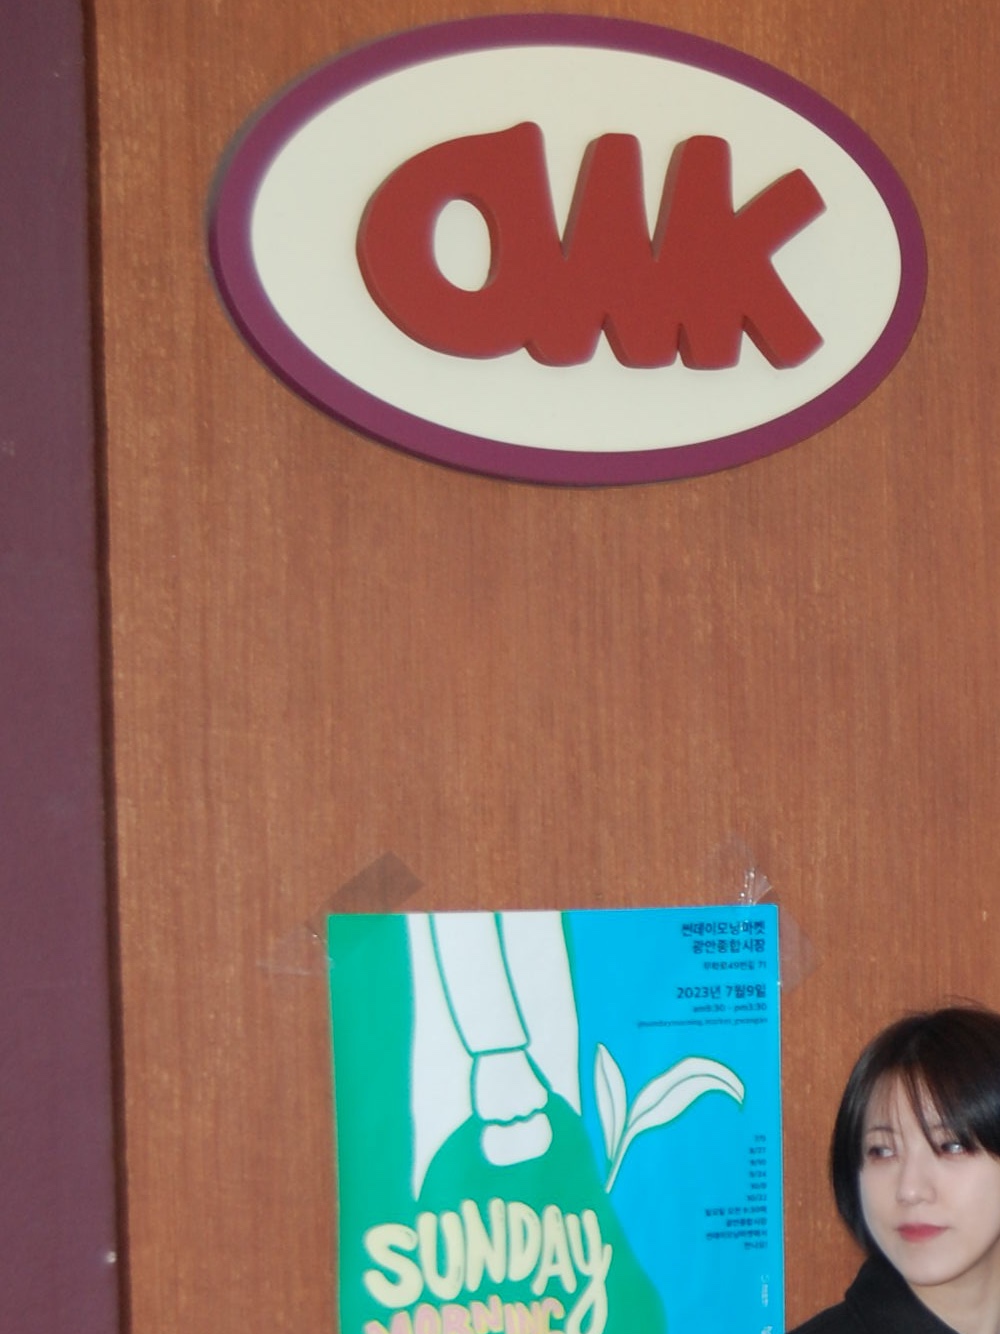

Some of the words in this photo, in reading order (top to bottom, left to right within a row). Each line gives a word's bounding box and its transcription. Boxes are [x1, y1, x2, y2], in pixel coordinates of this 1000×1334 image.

[356, 121, 826, 370] OWK
[676, 985, 721, 1000] 2023년
[726, 983, 767, 999] 7월9일
